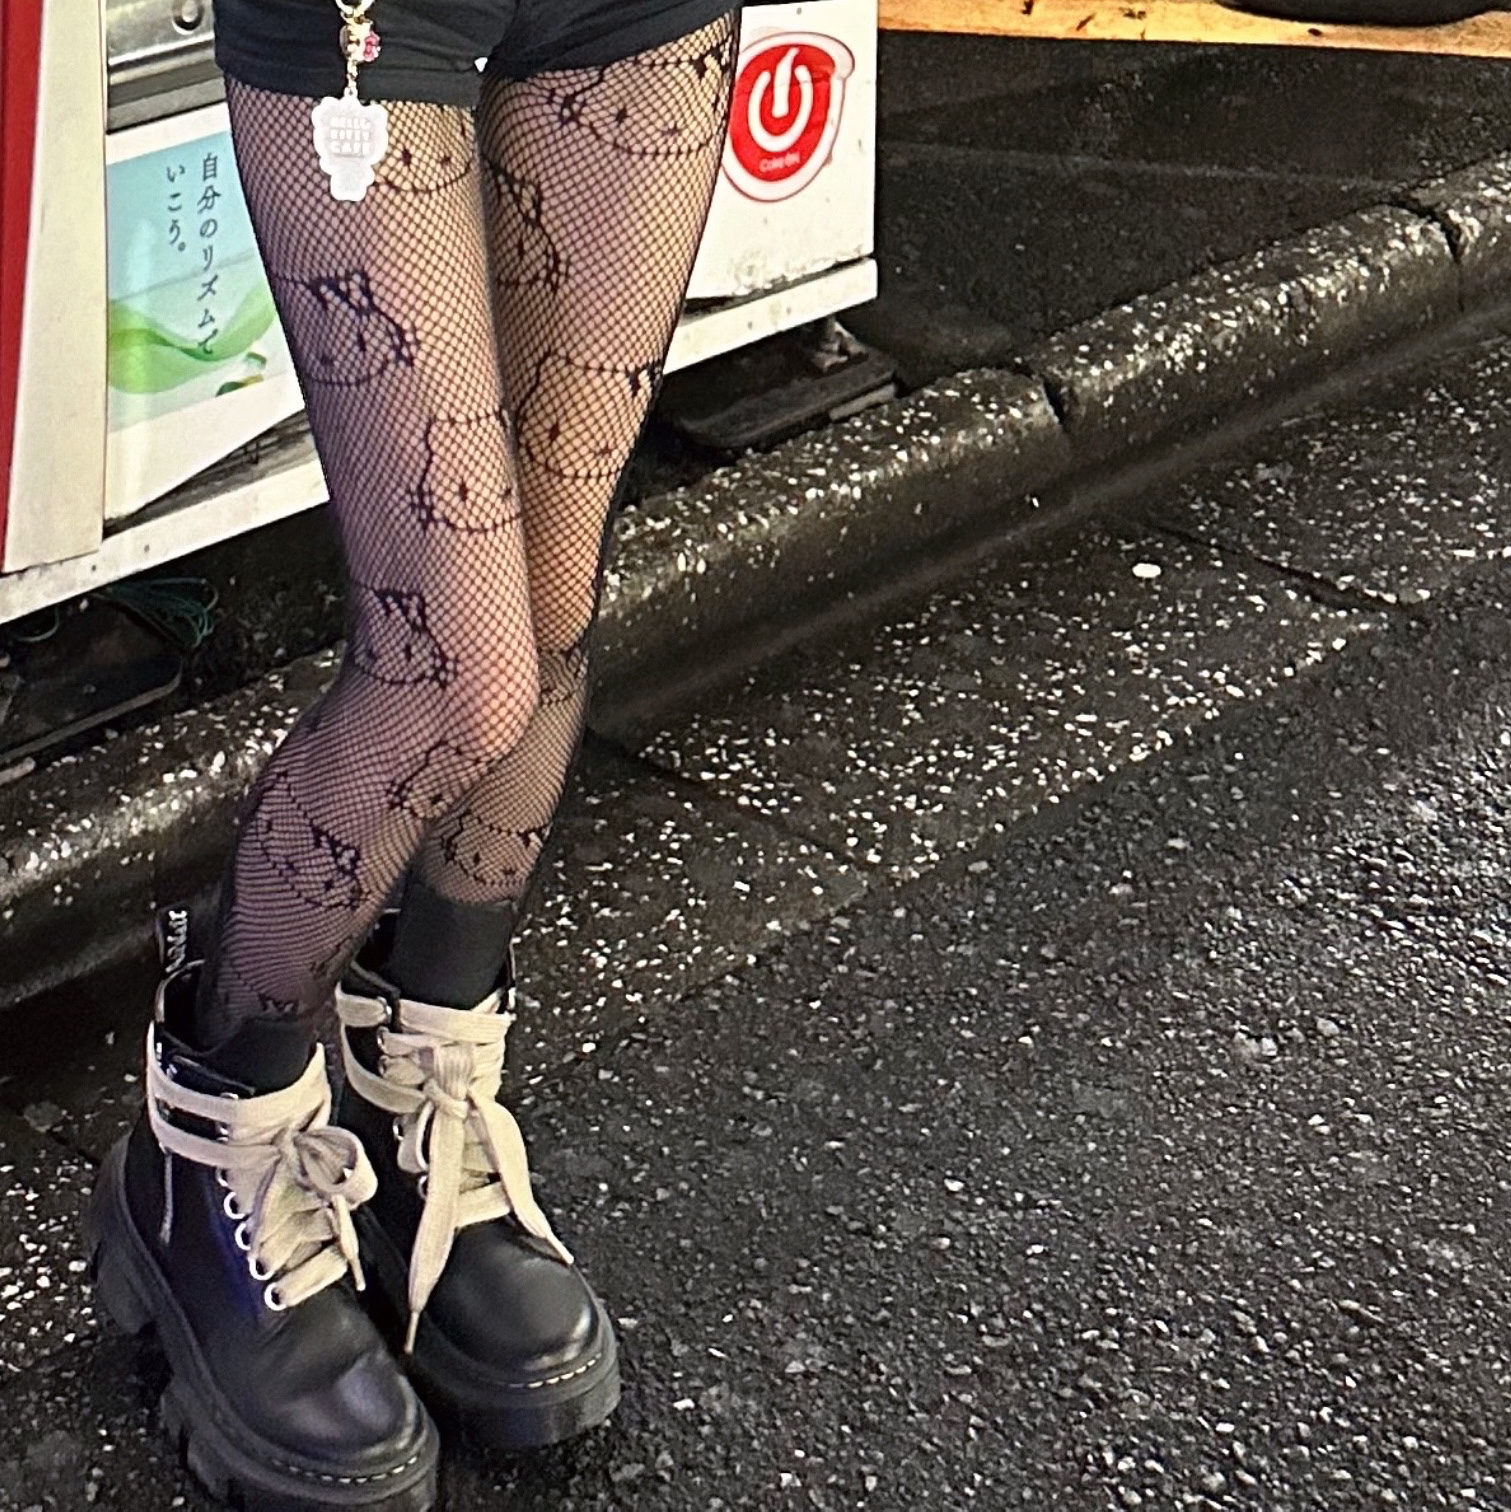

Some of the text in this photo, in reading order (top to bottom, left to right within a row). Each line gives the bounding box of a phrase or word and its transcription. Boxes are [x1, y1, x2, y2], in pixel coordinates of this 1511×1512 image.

[165, 163, 187, 253] いこう。
[196, 151, 222, 356] 自分のリズムで
